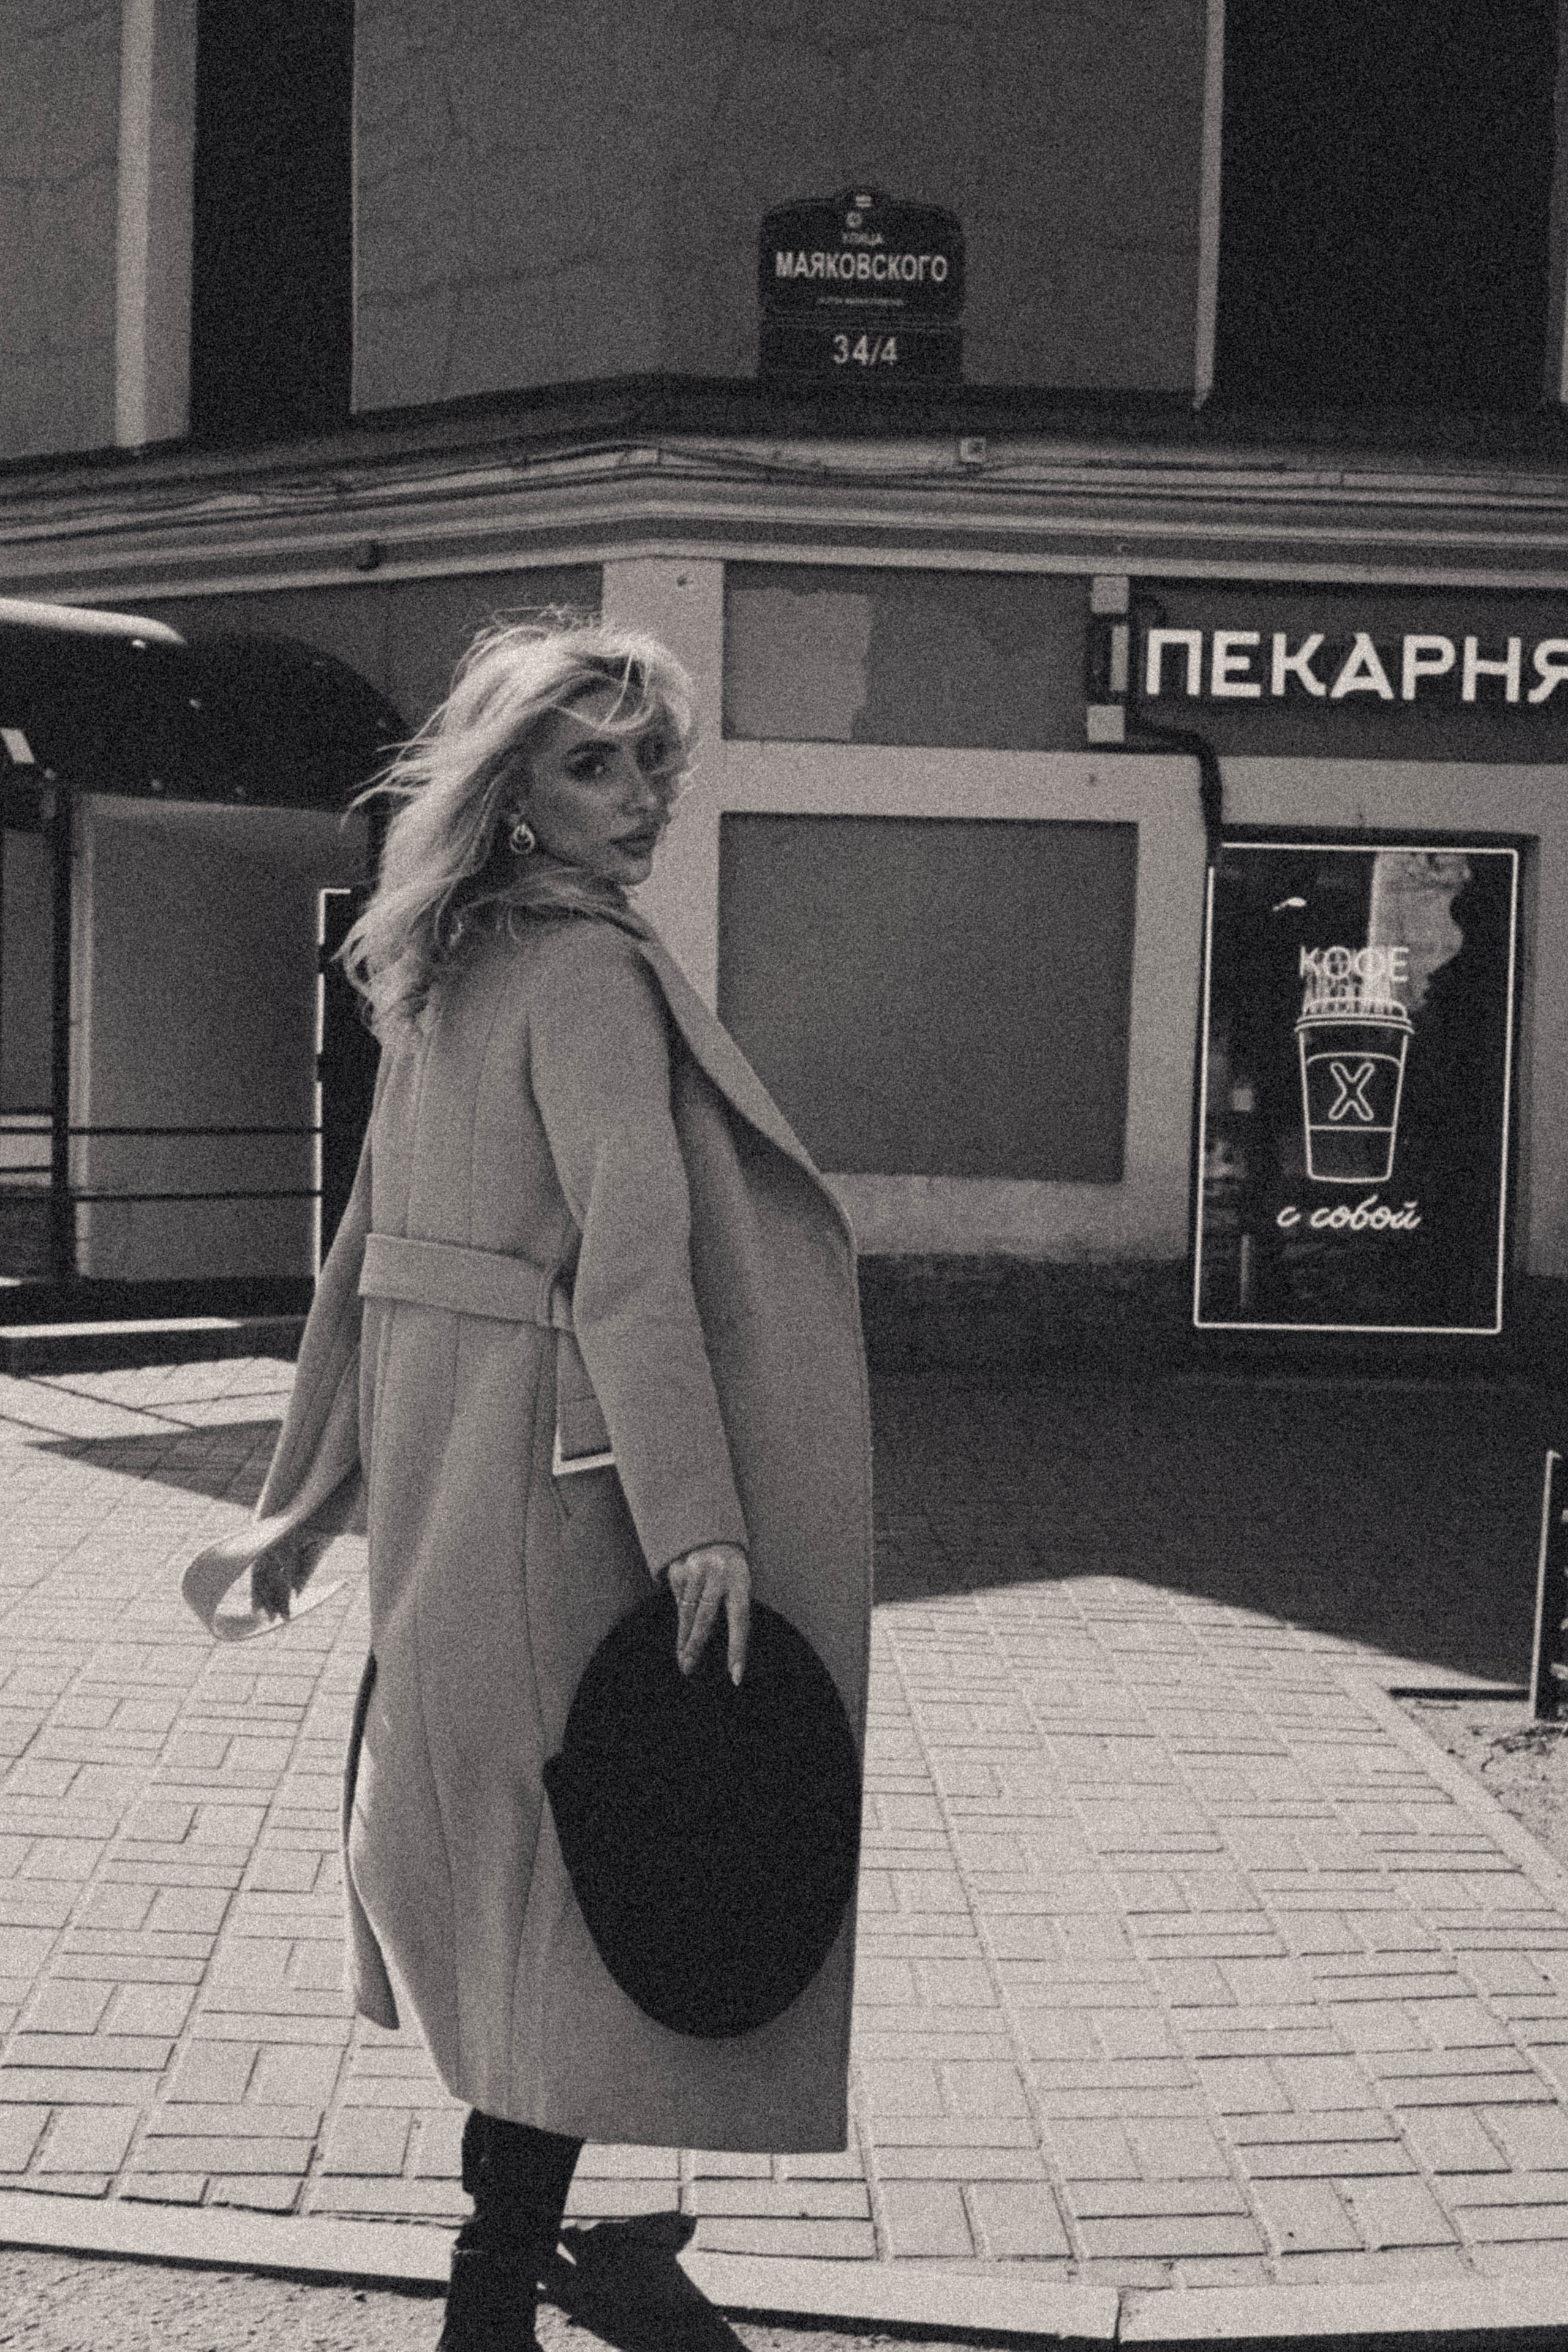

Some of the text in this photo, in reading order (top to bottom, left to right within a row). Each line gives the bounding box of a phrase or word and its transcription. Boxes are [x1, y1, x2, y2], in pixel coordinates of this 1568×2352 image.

[775, 251, 948, 281] МАЯКОВСКОГО
[834, 335, 897, 366] 34/4
[1145, 629, 1568, 703] ПЕКАРНЯ
[1300, 946, 1410, 982] КОФЕ
[1276, 1194, 1422, 1231] с собой
